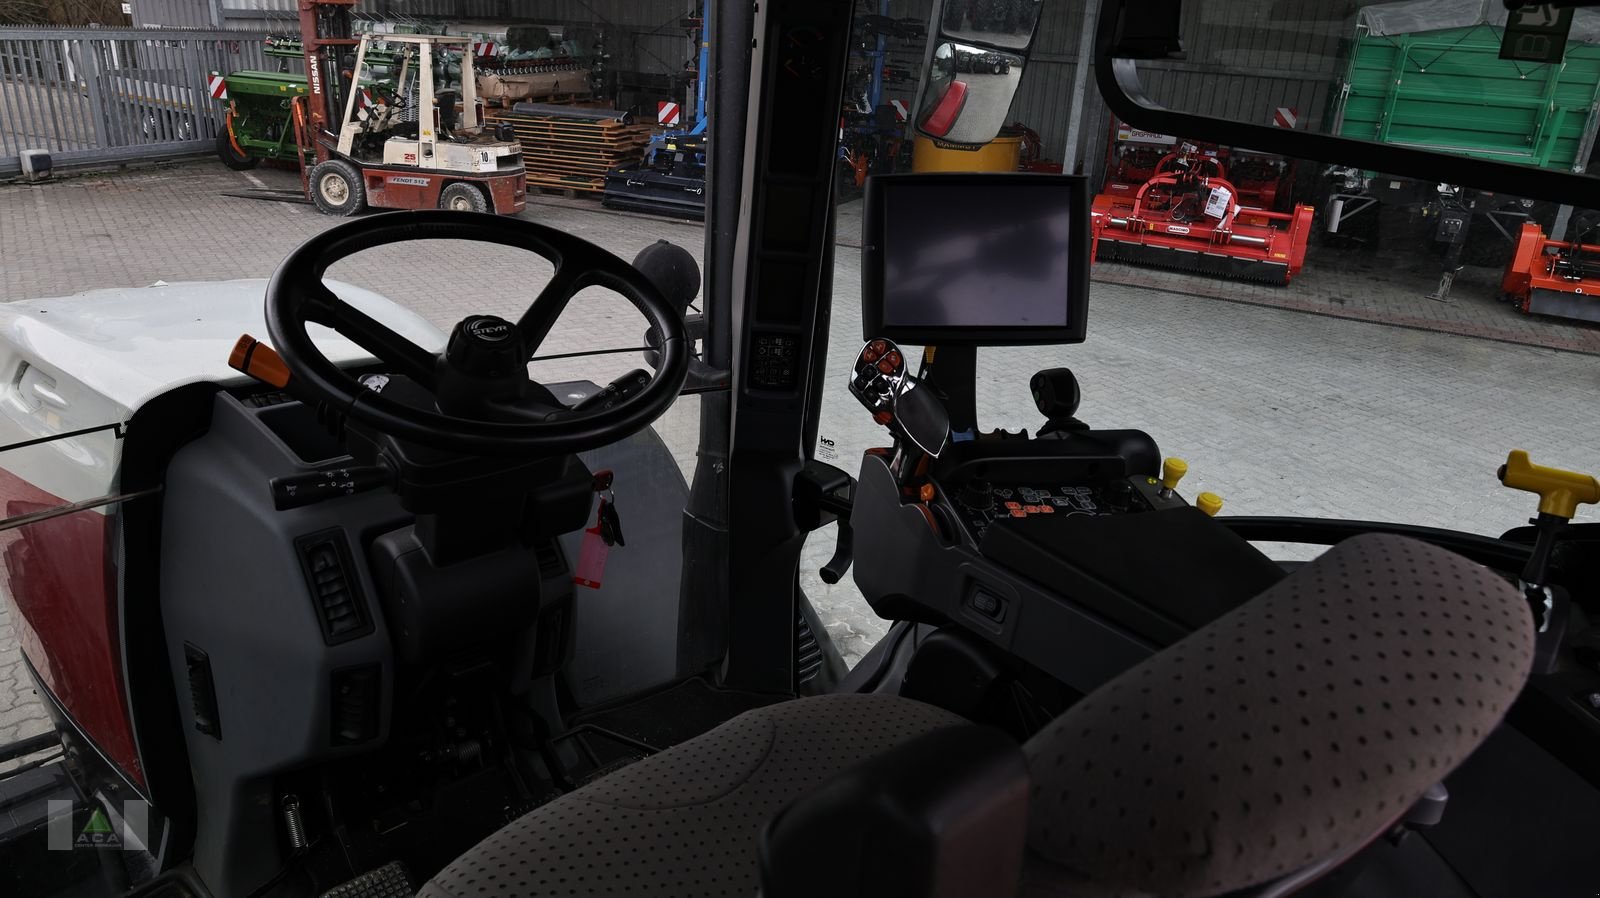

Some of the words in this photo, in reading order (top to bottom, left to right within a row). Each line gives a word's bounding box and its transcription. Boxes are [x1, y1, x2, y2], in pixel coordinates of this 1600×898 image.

[310, 55, 321, 95] NISSAN
[404, 153, 416, 161] 25
[481, 151, 489, 163] 10
[473, 325, 508, 336] STEYR
